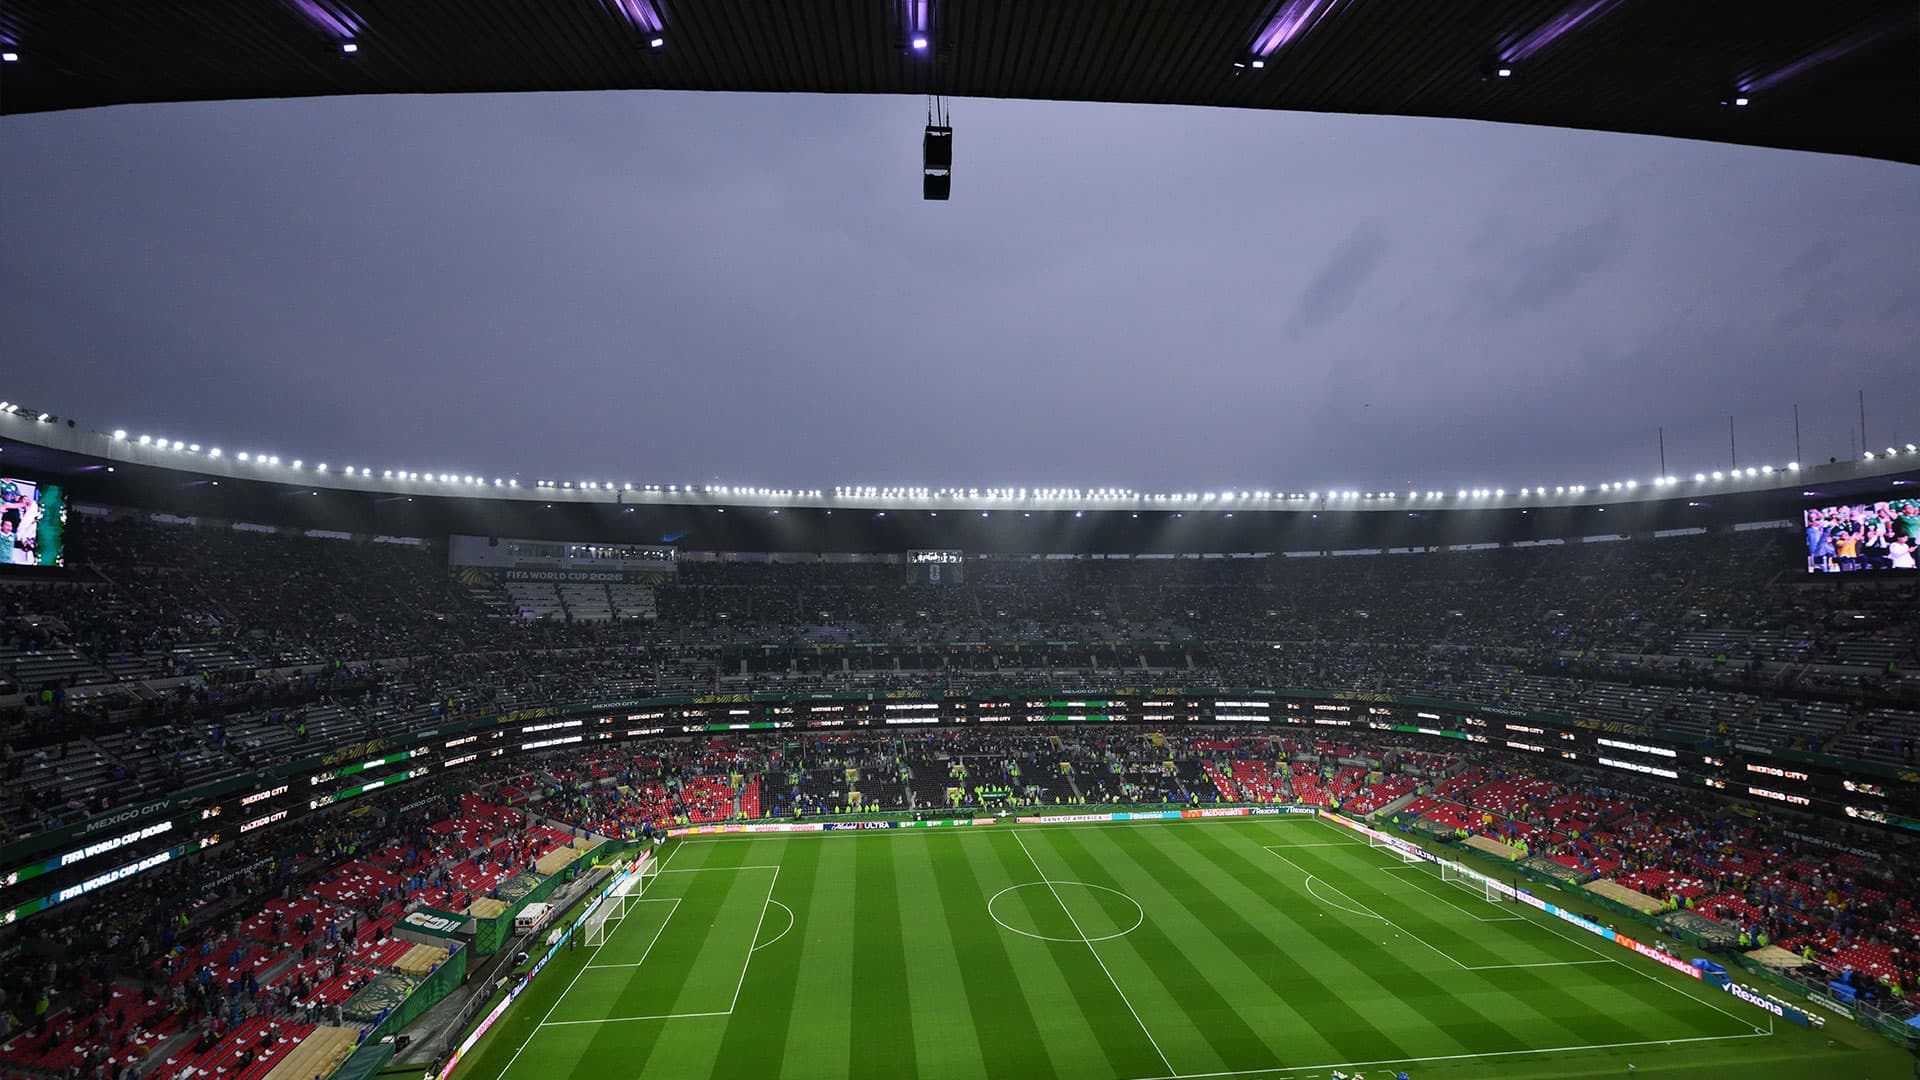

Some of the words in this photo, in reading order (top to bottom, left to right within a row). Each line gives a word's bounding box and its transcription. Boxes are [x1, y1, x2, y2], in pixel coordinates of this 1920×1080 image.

[506, 571, 528, 580] FIFA
[529, 571, 567, 580] WORLD
[567, 572, 588, 581] CUP
[589, 572, 624, 582] 2026
[1784, 770, 1809, 781] CITY
[271, 785, 289, 796] CITY
[1786, 794, 1810, 806] CITY
[87, 809, 139, 832] MEXICO
[141, 800, 170, 815] CITY
[270, 810, 288, 822] CITY
[864, 821, 890, 829] ULTRA
[61, 849, 85, 866] FIFA
[85, 838, 121, 857] WORLD
[121, 831, 141, 845] CUP
[59, 885, 83, 902] FIFA
[83, 871, 119, 892] WORLD
[119, 863, 139, 878] CUP
[1555, 906, 1604, 936] Hisense
[1635, 942, 1699, 978] McDonald's
[1731, 983, 1783, 1017] Rexona
